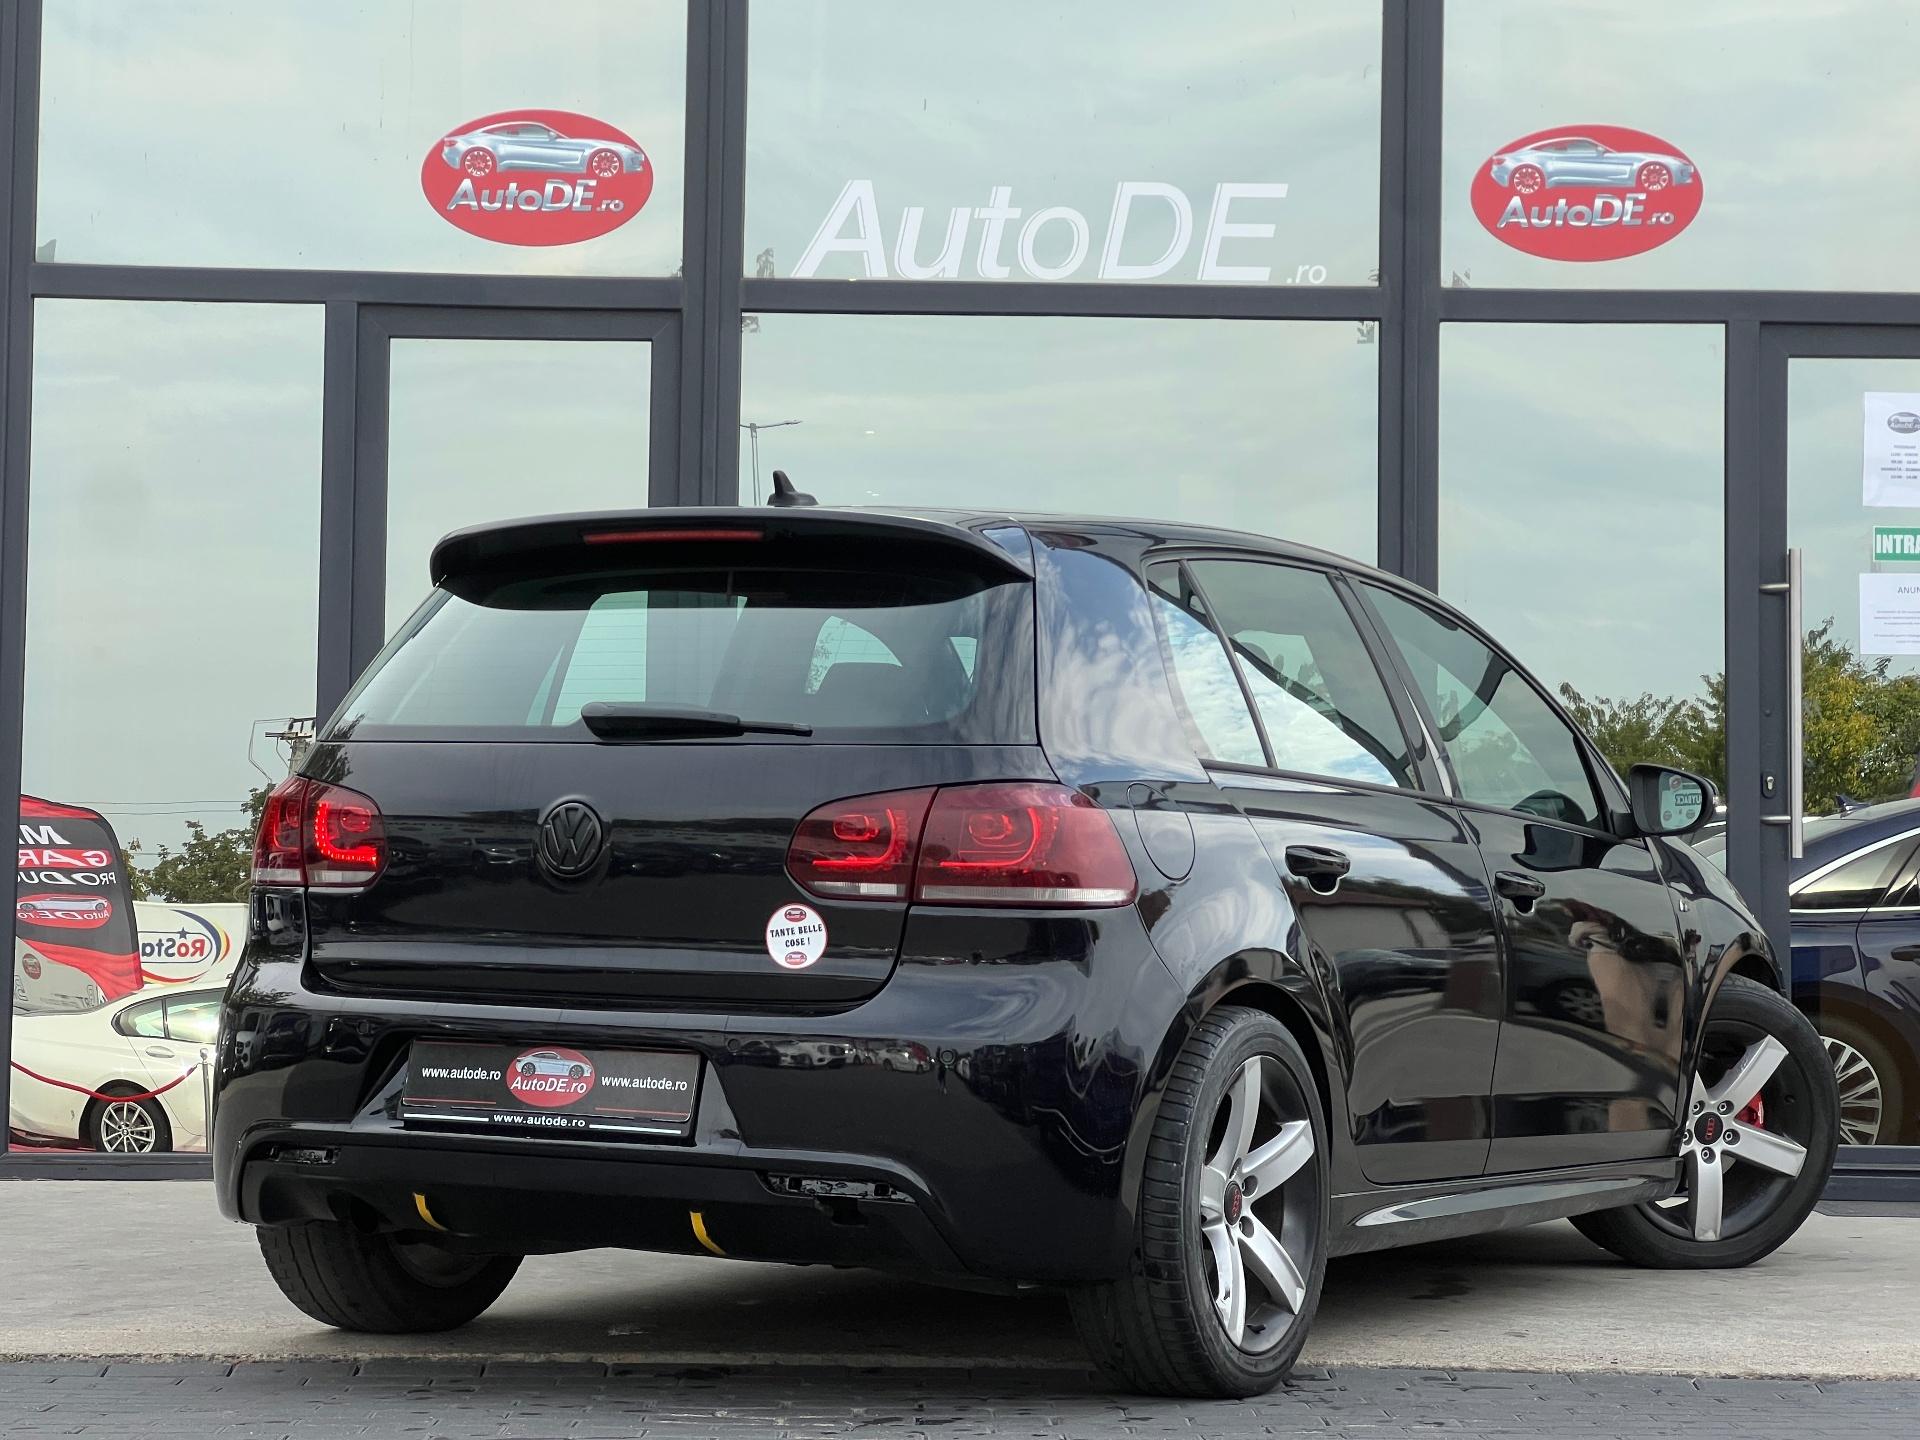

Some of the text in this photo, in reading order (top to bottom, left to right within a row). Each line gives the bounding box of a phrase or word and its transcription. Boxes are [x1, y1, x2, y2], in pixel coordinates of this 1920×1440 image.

[770, 923, 823, 938] TANTE BELLE
[785, 937, 805, 947] COSE
[421, 1066, 501, 1081] www.autode.ro
[510, 1075, 587, 1094] AutoDE.ro
[601, 1075, 688, 1091] www.autode.ro
[493, 1112, 586, 1128] www.autode.ro
